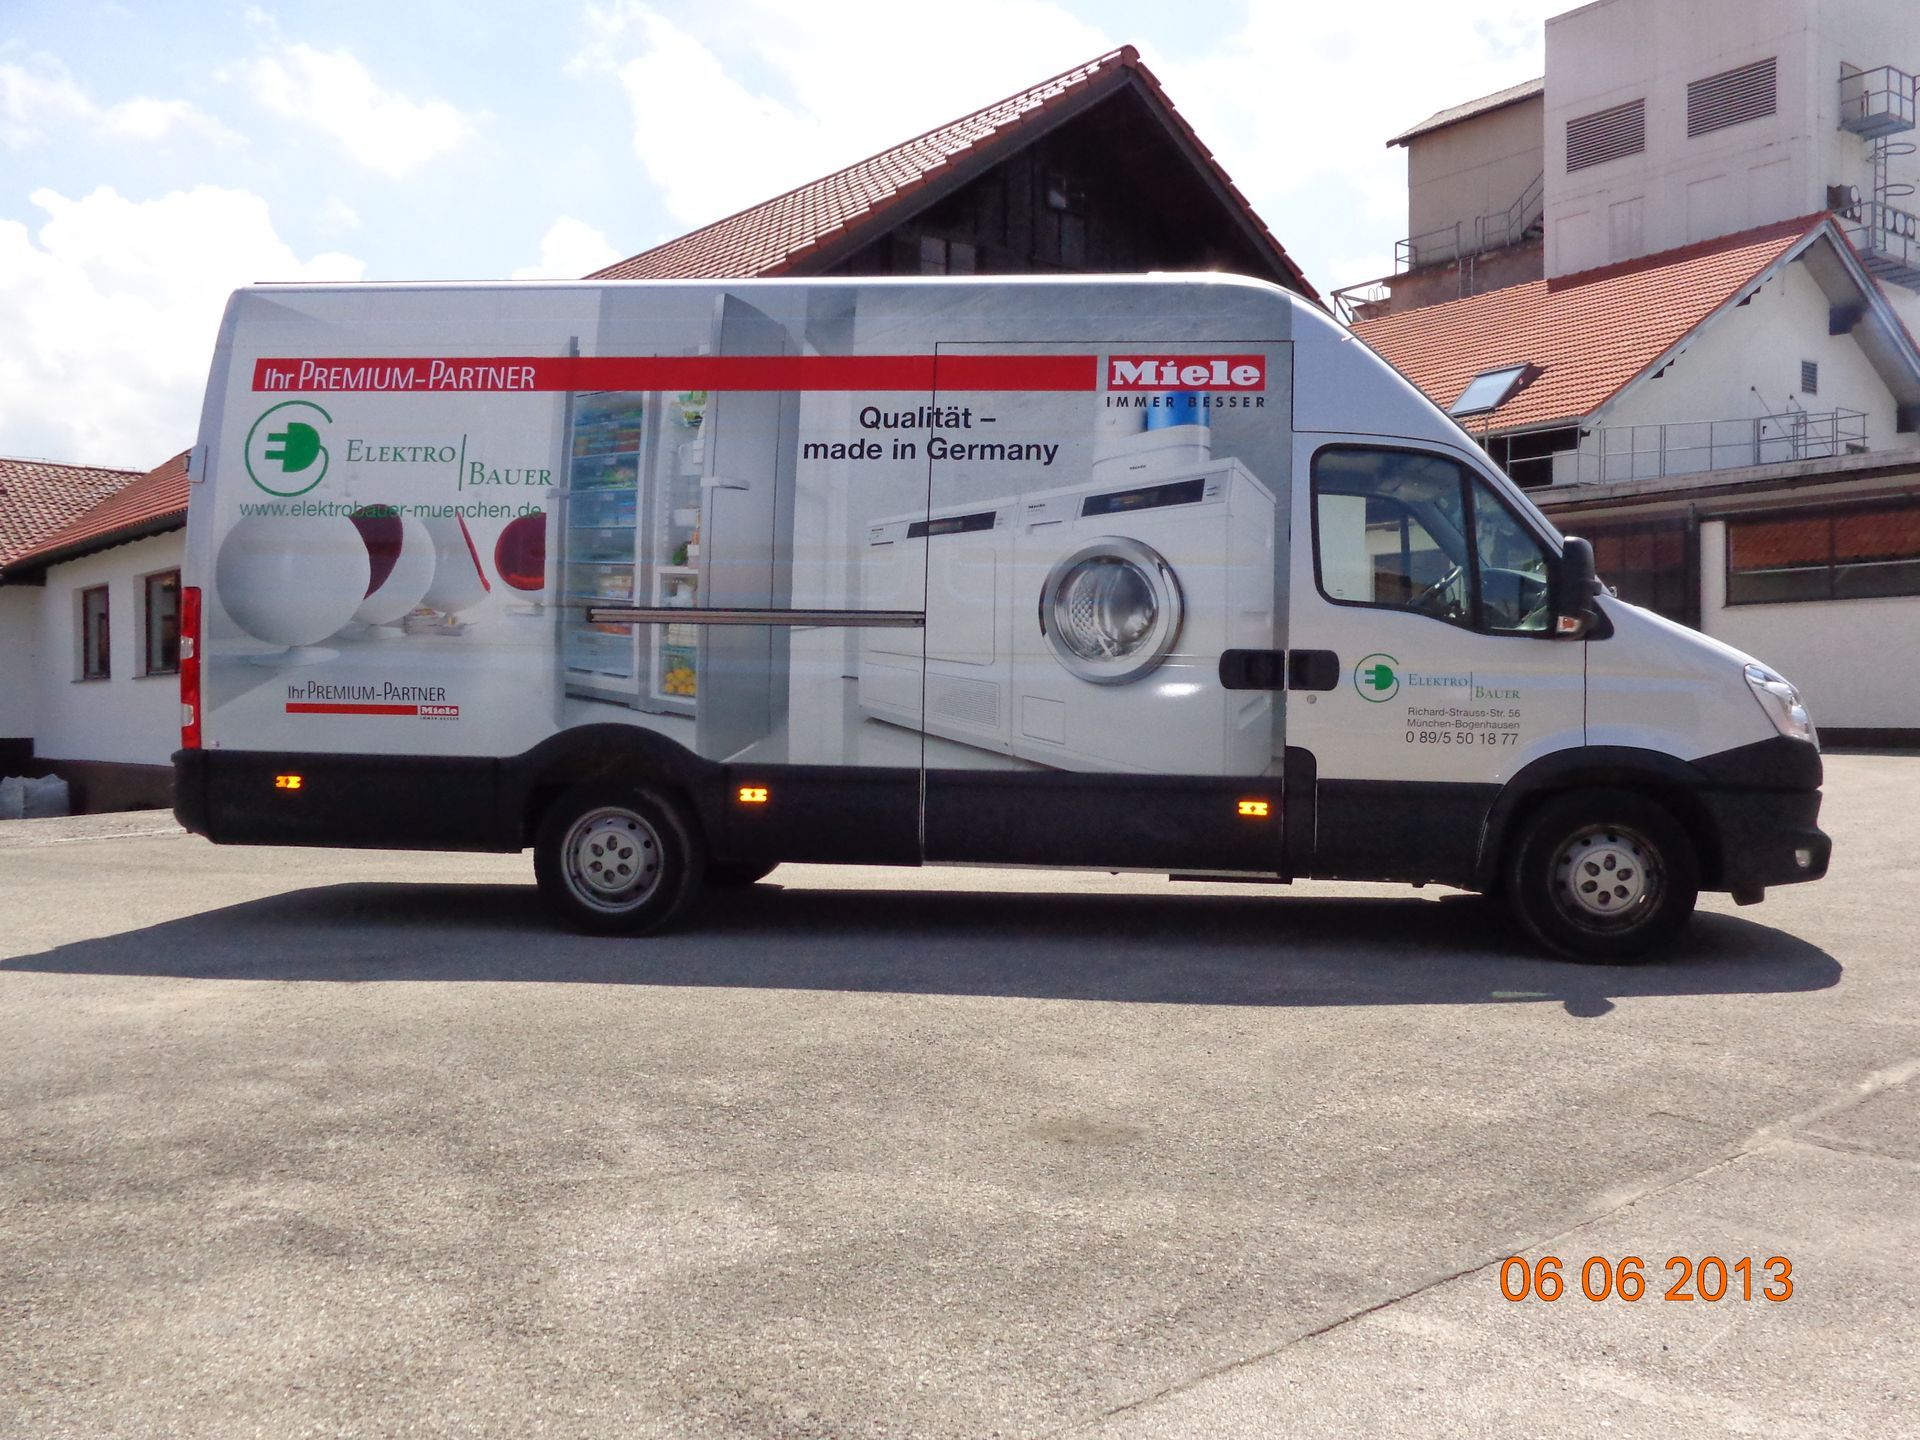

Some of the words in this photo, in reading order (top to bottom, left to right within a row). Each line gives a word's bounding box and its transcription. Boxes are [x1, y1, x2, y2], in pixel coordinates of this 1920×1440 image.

[264, 368, 294, 389] Ihr
[298, 360, 536, 389] PREMIUM-PARTNER
[1112, 360, 1261, 386] Miele
[1106, 396, 1175, 408] IMMER
[1188, 396, 1265, 408] BESSER
[859, 406, 972, 430] Qualität
[346, 439, 456, 463] ELEKTRO
[803, 438, 883, 460] made
[892, 438, 916, 460] in
[927, 436, 1059, 466] Germany
[468, 461, 553, 486] BAUER
[239, 500, 543, 518] www.elektrobauer-muenchen.de
[1408, 673, 1468, 687] ELEKTRO
[288, 685, 305, 699] Ihr
[307, 680, 446, 702] PREMIUM-PARTNER
[1475, 686, 1520, 699] BAUER
[421, 706, 458, 715] Miele
[1407, 706, 1505, 718] Richard-Strauss-Str.
[1508, 709, 1521, 718] 56
[1407, 719, 1520, 730] München-Bogenhausen
[1405, 731, 1415, 743] 0
[1419, 731, 1452, 744] 89/5
[1456, 732, 1474, 745] 50
[1480, 732, 1496, 745] 18
[1501, 733, 1519, 745] 77
